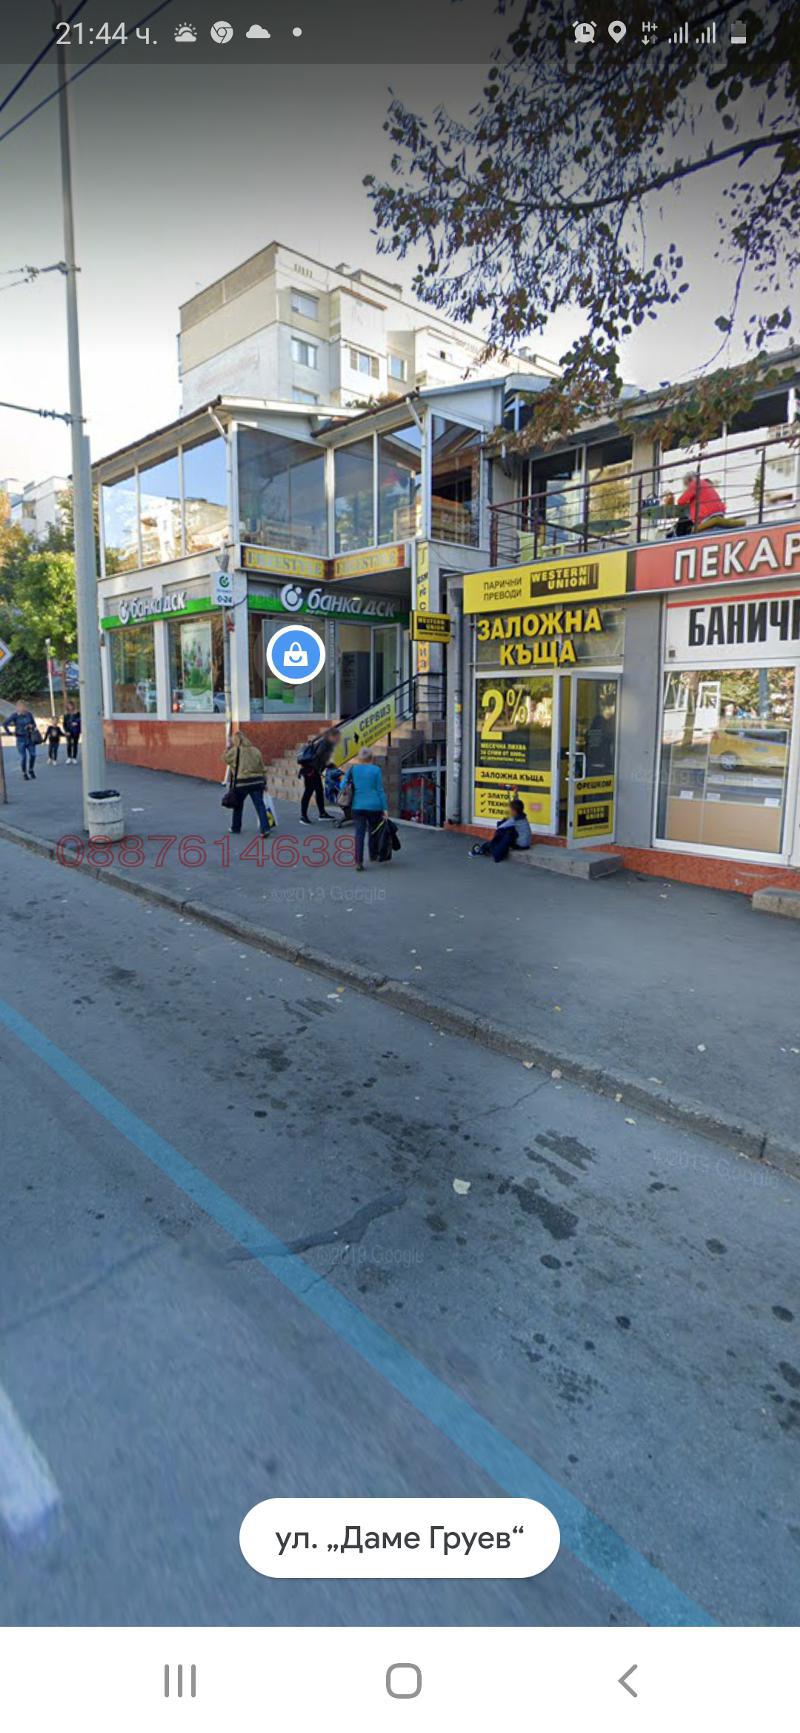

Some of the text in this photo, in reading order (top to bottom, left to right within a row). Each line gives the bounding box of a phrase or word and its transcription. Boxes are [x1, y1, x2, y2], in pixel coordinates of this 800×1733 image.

[530, 566, 588, 583] WESTERN
[547, 575, 588, 590] UNION
[483, 577, 522, 591] ПАРИЧНИ
[483, 588, 522, 601] ПРЕВОДИ
[477, 609, 603, 641] ЗАЛОЖНА
[499, 640, 577, 667] КЪЩА
[359, 703, 391, 732] СЕРВИЗ
[480, 689, 529, 741] 2%
[481, 770, 545, 783] ЗАЛОЖНА КЪЩА
